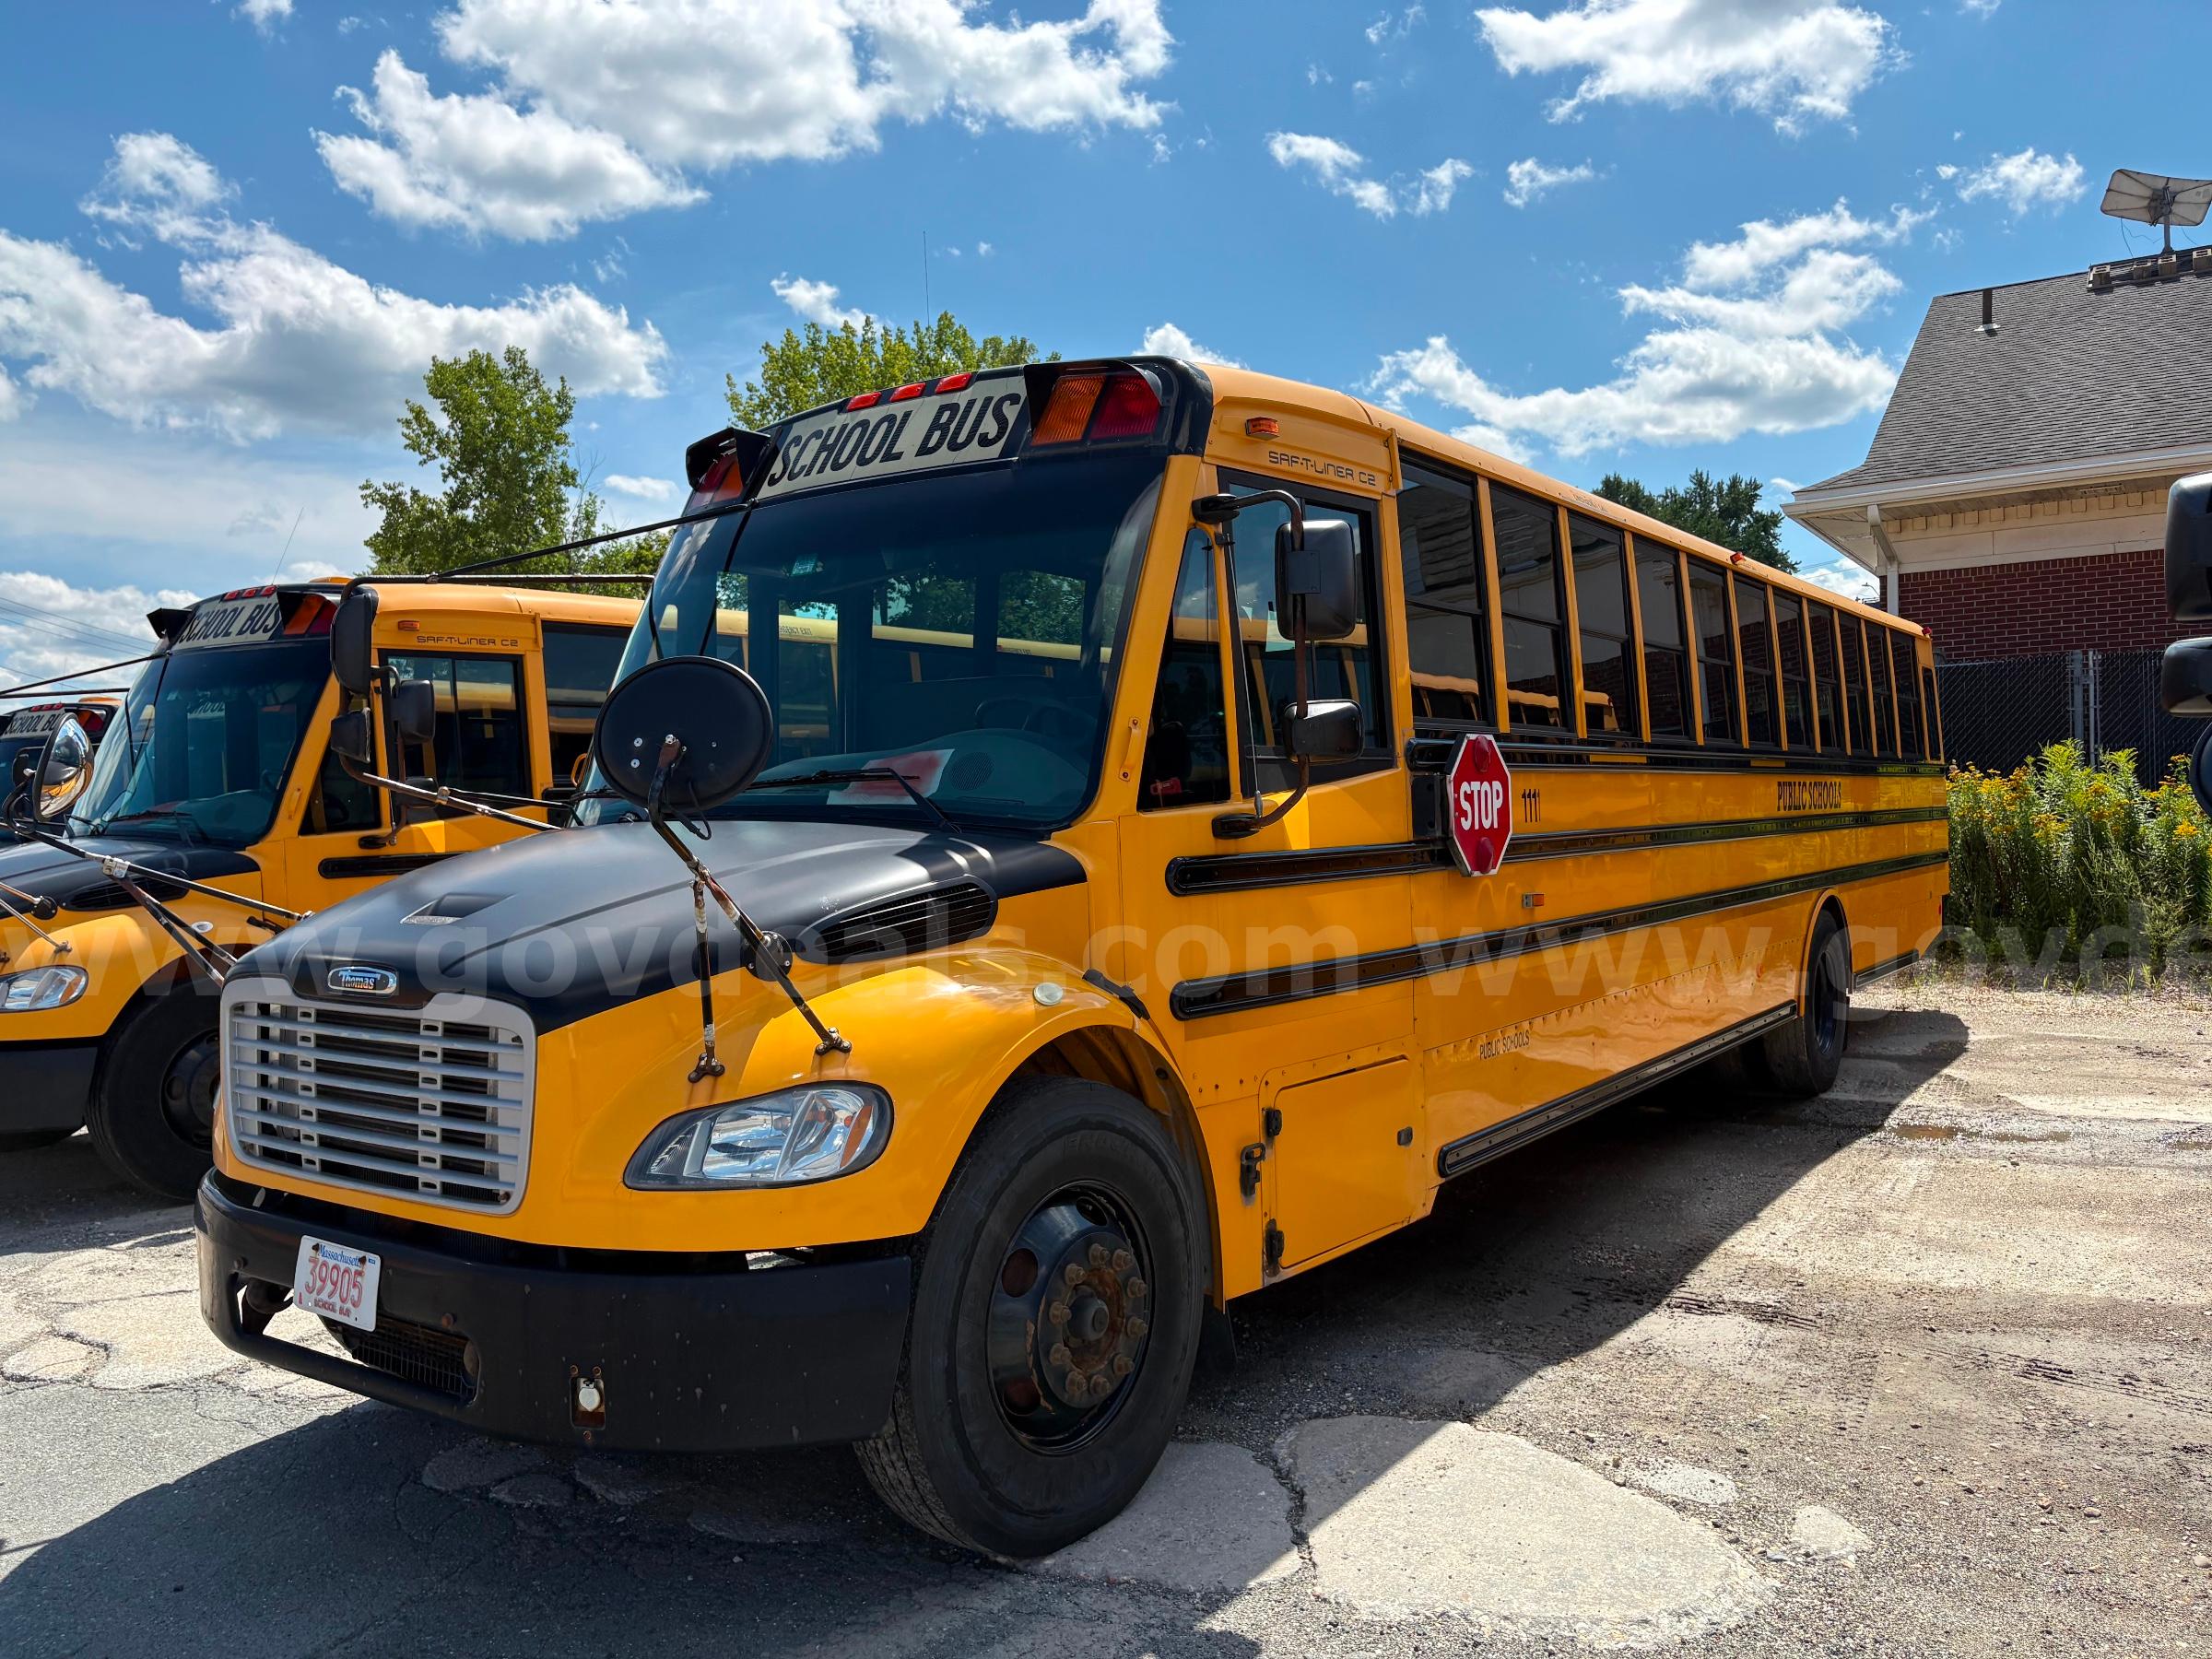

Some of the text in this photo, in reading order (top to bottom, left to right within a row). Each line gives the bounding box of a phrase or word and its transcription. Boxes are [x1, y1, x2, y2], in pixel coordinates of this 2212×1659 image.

[767, 393, 1022, 488] SCHOOL BUS
[1268, 451, 1376, 487] SAF-T-LINER C2
[179, 602, 281, 644] SCHOOL BUS
[500, 639, 518, 647] C2
[5, 715, 44, 735] SCHOOL
[1459, 781, 1503, 830] STOP
[1777, 781, 1841, 811] PUBLIC SCHOOLS
[338, 971, 382, 990] Thomas
[1479, 1030, 1530, 1060] PUBLIC SCHOOLS
[304, 1255, 365, 1309] 39905
